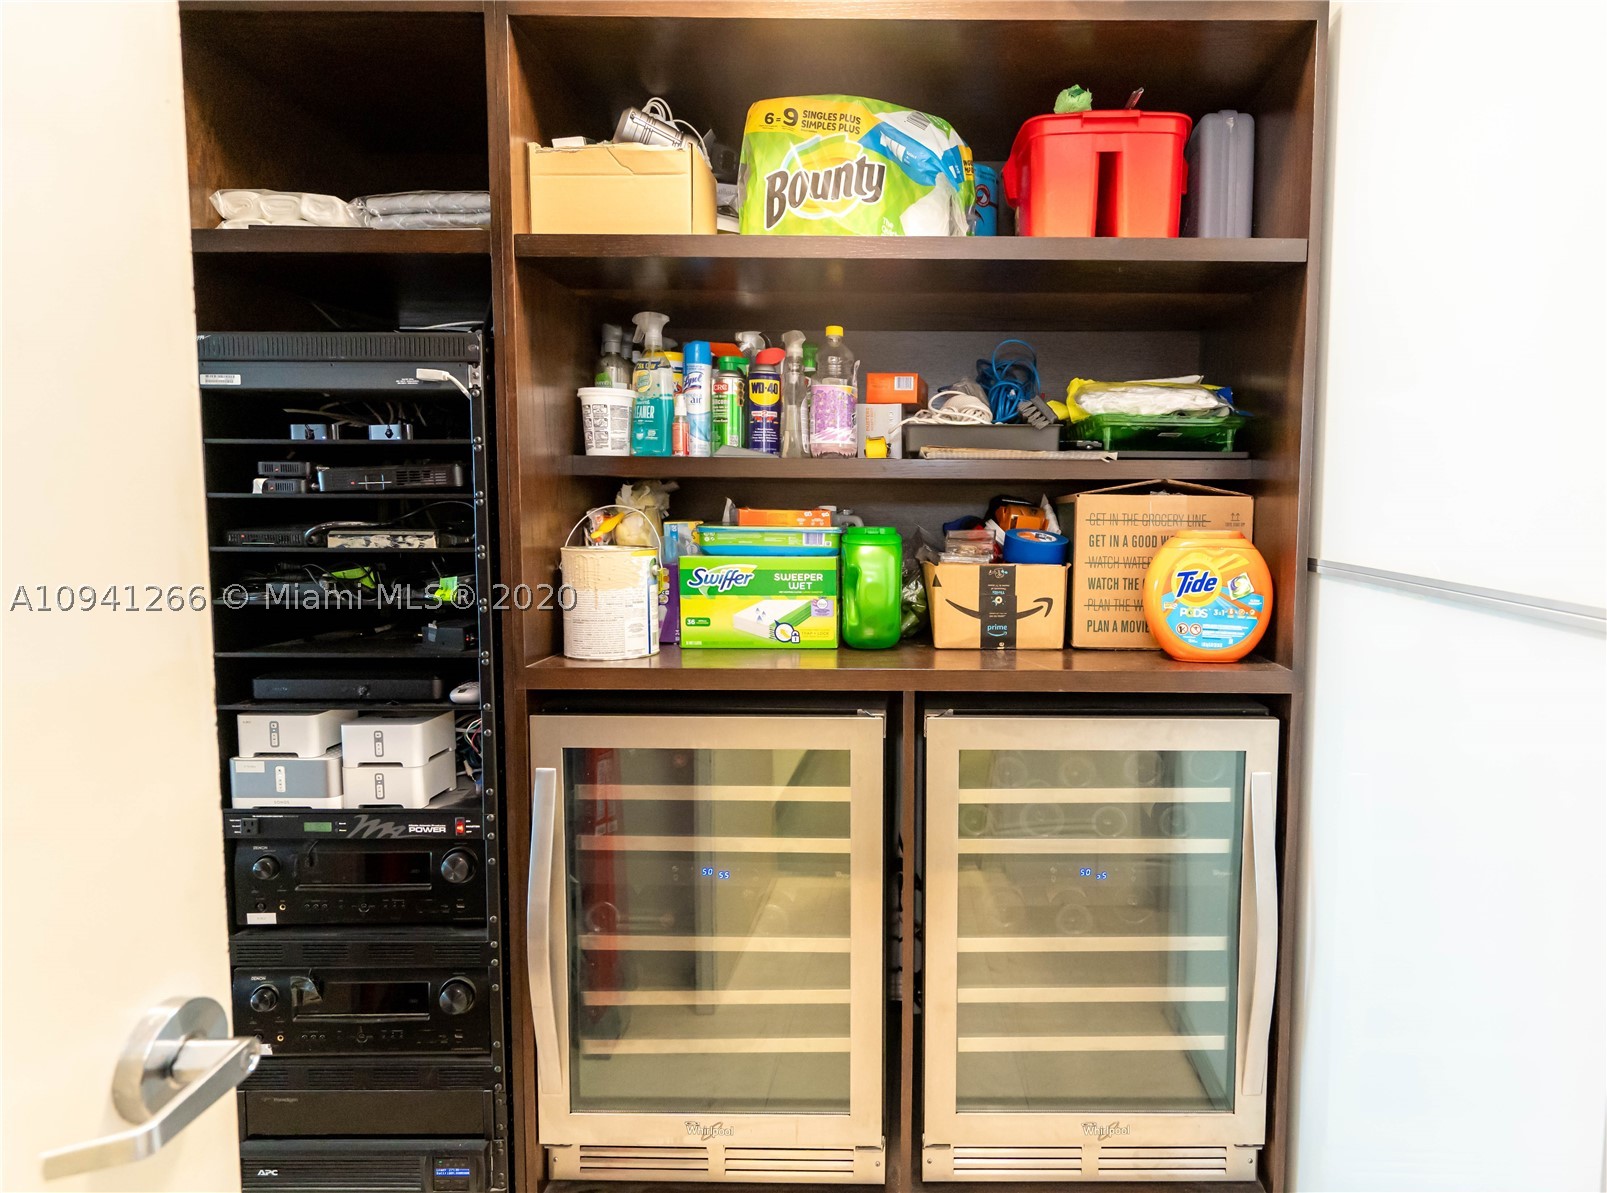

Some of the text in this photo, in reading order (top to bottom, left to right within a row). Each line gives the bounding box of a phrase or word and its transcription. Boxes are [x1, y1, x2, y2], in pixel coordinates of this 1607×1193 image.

[802, 109, 861, 125] SINGLES PLUS
[801, 120, 837, 131] SIMPLES
[838, 123, 861, 134] PLUS
[765, 155, 886, 229] Bounty
[713, 383, 728, 391] CRC
[751, 382, 778, 395] WD-40
[634, 405, 655, 419] LEANER
[1089, 512, 1207, 528] GET IN THE GROCERY LINE
[1088, 534, 1106, 548] GET
[1109, 534, 1119, 548] IN
[1122, 534, 1129, 548] A
[1131, 535, 1158, 548] GOOD
[1088, 556, 1119, 569] WATCH
[689, 568, 754, 591] Swiffer
[774, 573, 823, 582] SWEEPER
[1087, 577, 1119, 590] WATCH
[1122, 577, 1139, 590] THE
[1176, 570, 1218, 598] Tide
[788, 581, 813, 590] WET
[1088, 598, 1110, 611] PLAN
[1114, 599, 1131, 612] THE
[1180, 607, 1209, 618] PODS
[987, 624, 1008, 632] prime
[1087, 620, 1150, 633] PLAN A MOVIE
[702, 868, 713, 876] 50
[1080, 868, 1091, 876] 50
[686, 1122, 735, 1139] Whirlpool
[1082, 1123, 1131, 1139] Whirlpool
